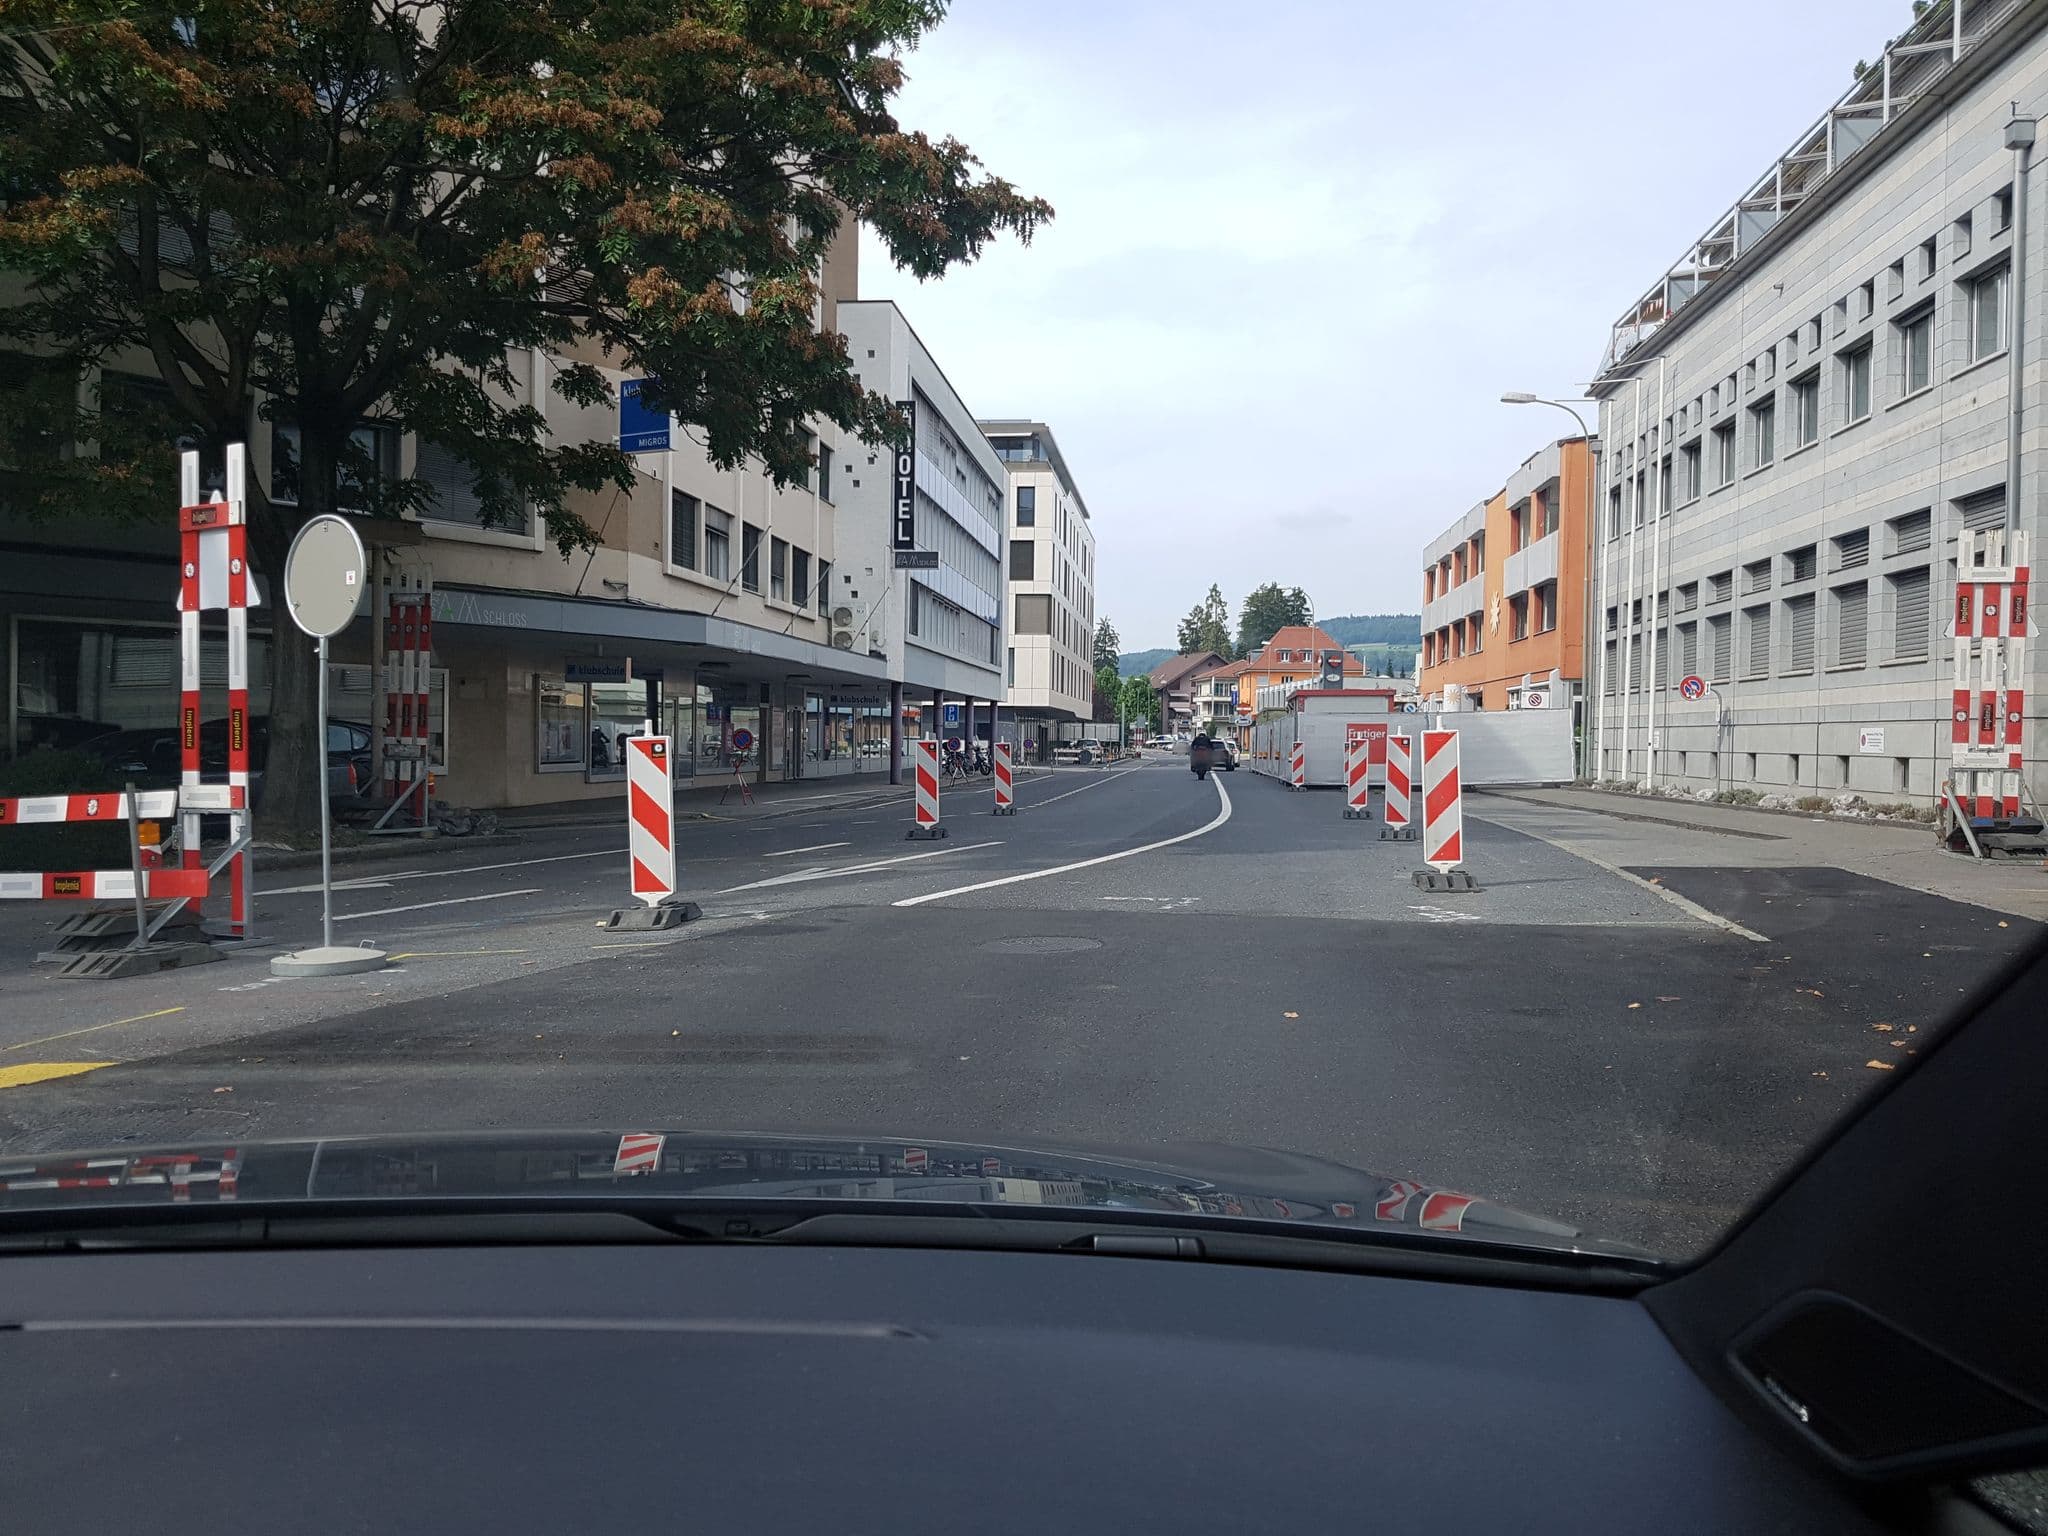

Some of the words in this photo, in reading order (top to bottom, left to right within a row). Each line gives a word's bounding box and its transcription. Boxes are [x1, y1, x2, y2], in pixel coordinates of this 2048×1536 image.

[638, 437, 667, 447] MIGROS
[482, 610, 528, 627] SCHLOSS
[185, 710, 194, 747] Implenia
[233, 711, 242, 749] Implenia
[1982, 704, 1992, 731] Implenia
